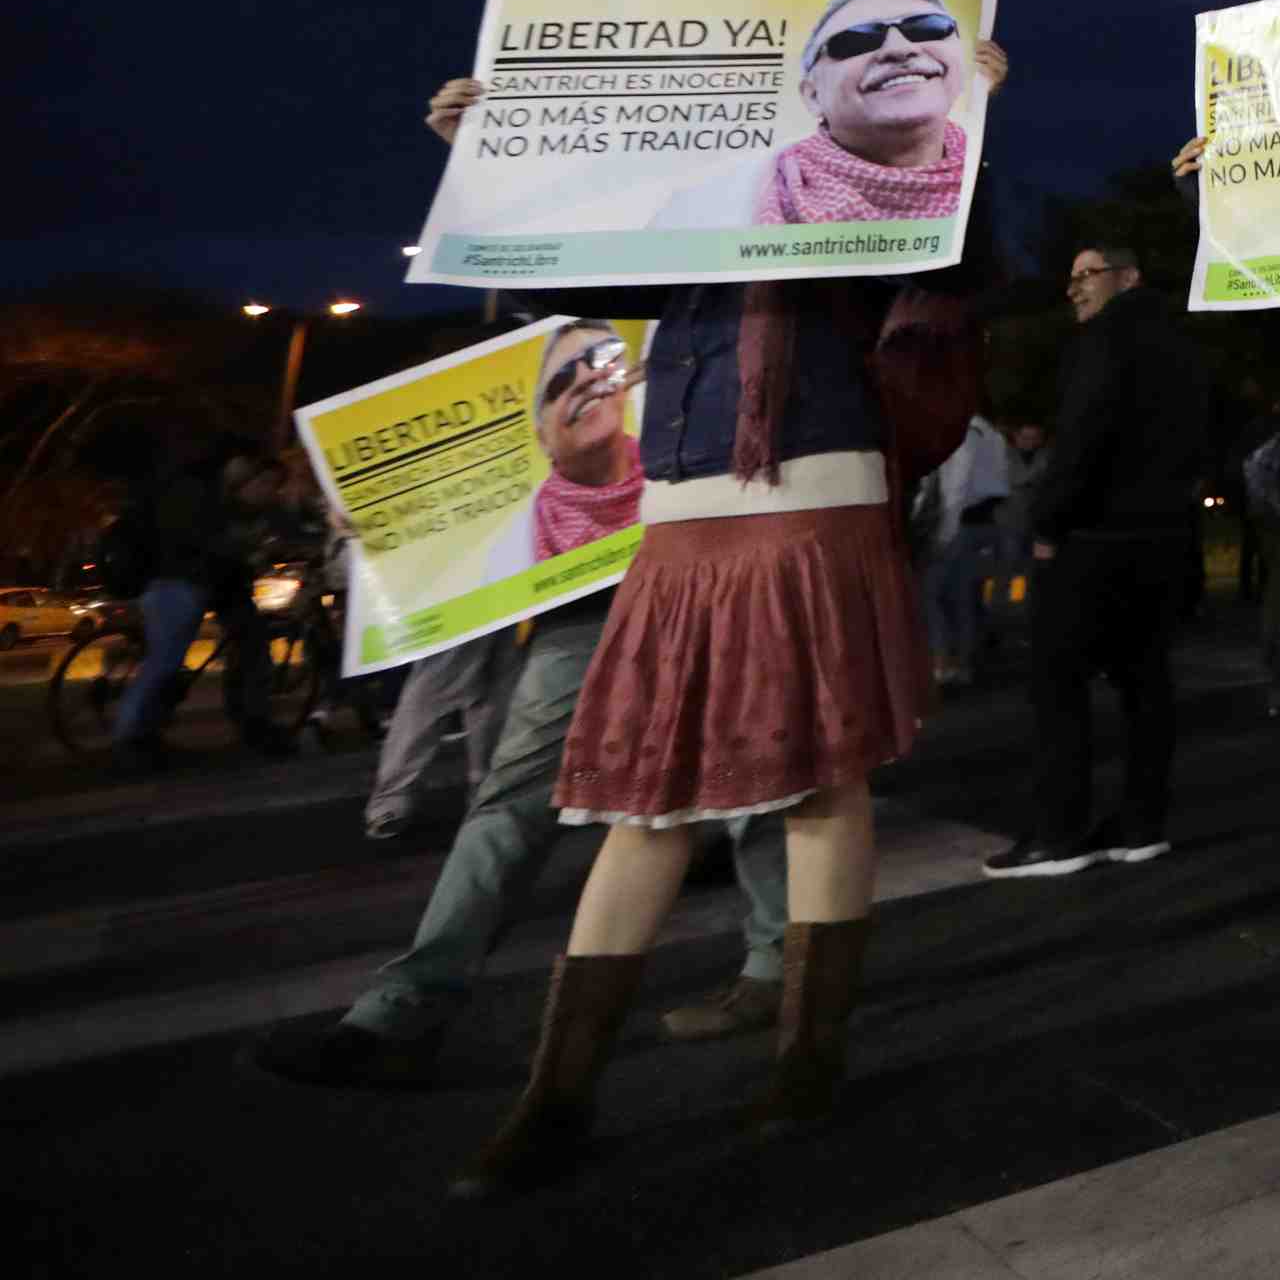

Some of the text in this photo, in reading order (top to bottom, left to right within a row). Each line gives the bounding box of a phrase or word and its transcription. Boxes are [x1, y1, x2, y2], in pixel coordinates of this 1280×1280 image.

[499, 18, 788, 52] LIBERTAD YA!
[489, 69, 785, 94] SANTRICH ES INOCENTE
[484, 98, 777, 130] NO MÁS MONTAJES
[478, 122, 774, 159] NO MÁS TRAICIÓN
[1210, 163, 1247, 188] NO
[740, 233, 940, 260] www.santrichlibre.org
[328, 399, 475, 470] LIBERTAD
